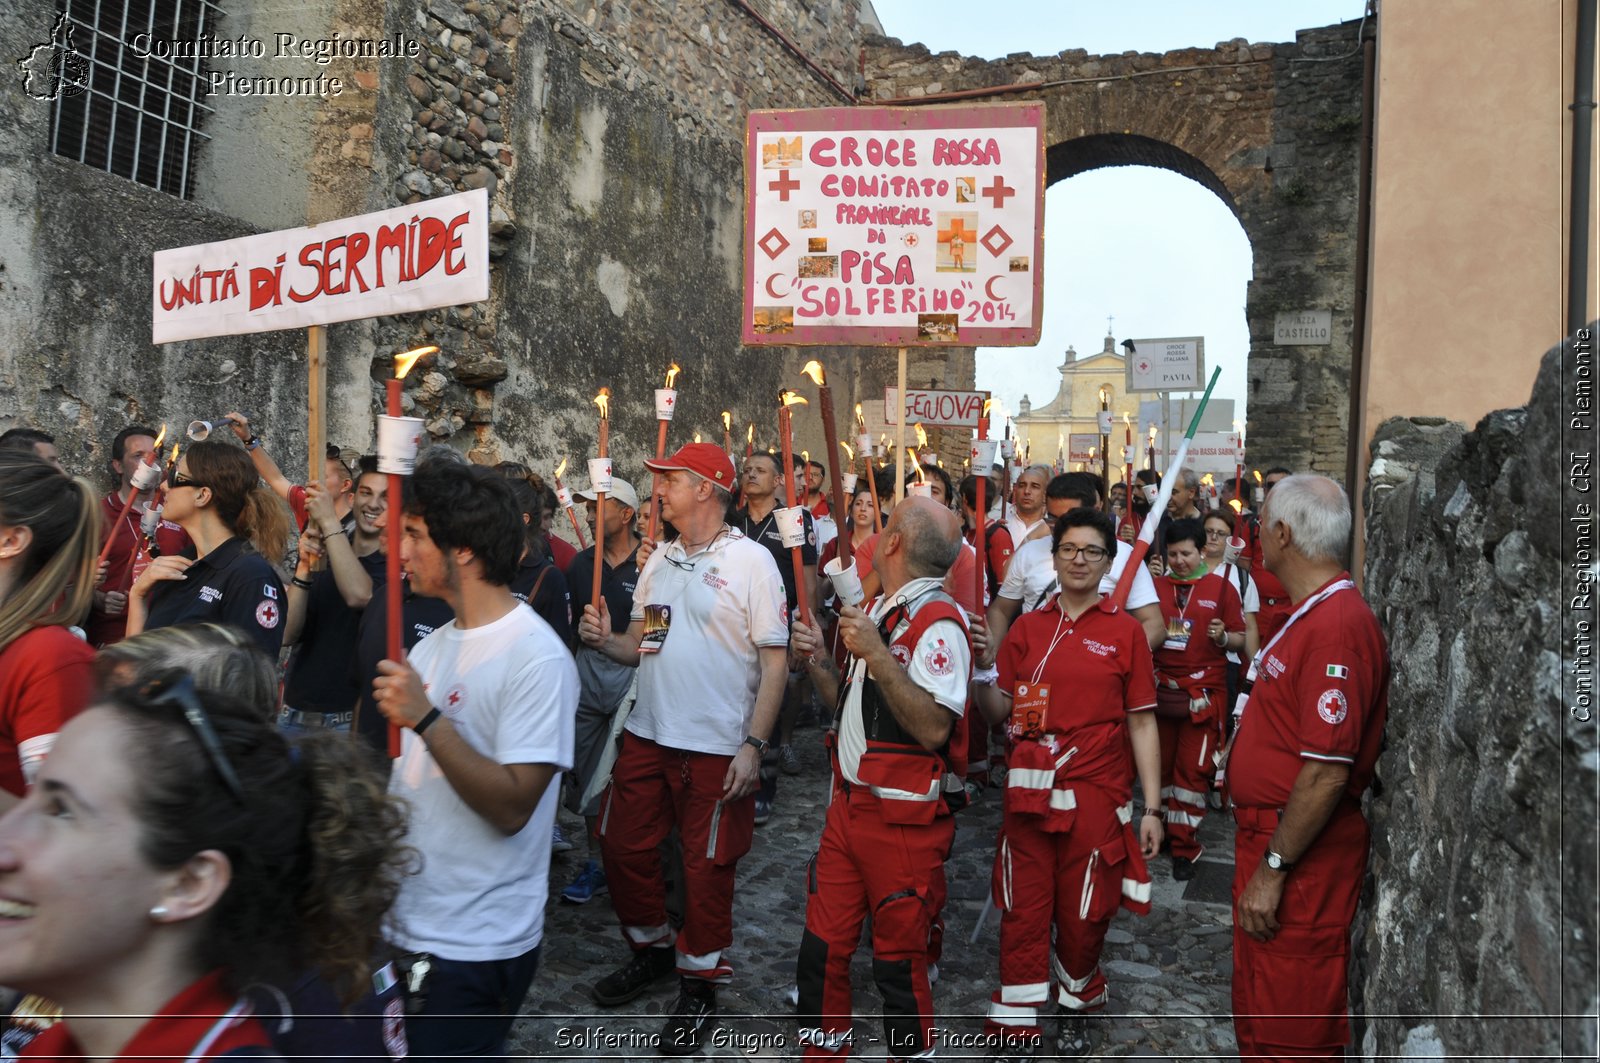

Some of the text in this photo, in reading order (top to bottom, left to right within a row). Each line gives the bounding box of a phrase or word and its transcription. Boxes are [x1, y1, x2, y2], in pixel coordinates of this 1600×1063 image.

[809, 137, 1001, 167] CROCE ROSSA
[963, 301, 1016, 323] 2014
[1278, 328, 1327, 338] CASTELLO
[1163, 374, 1191, 382] PAVIA
[1200, 448, 1217, 456] BASSA
